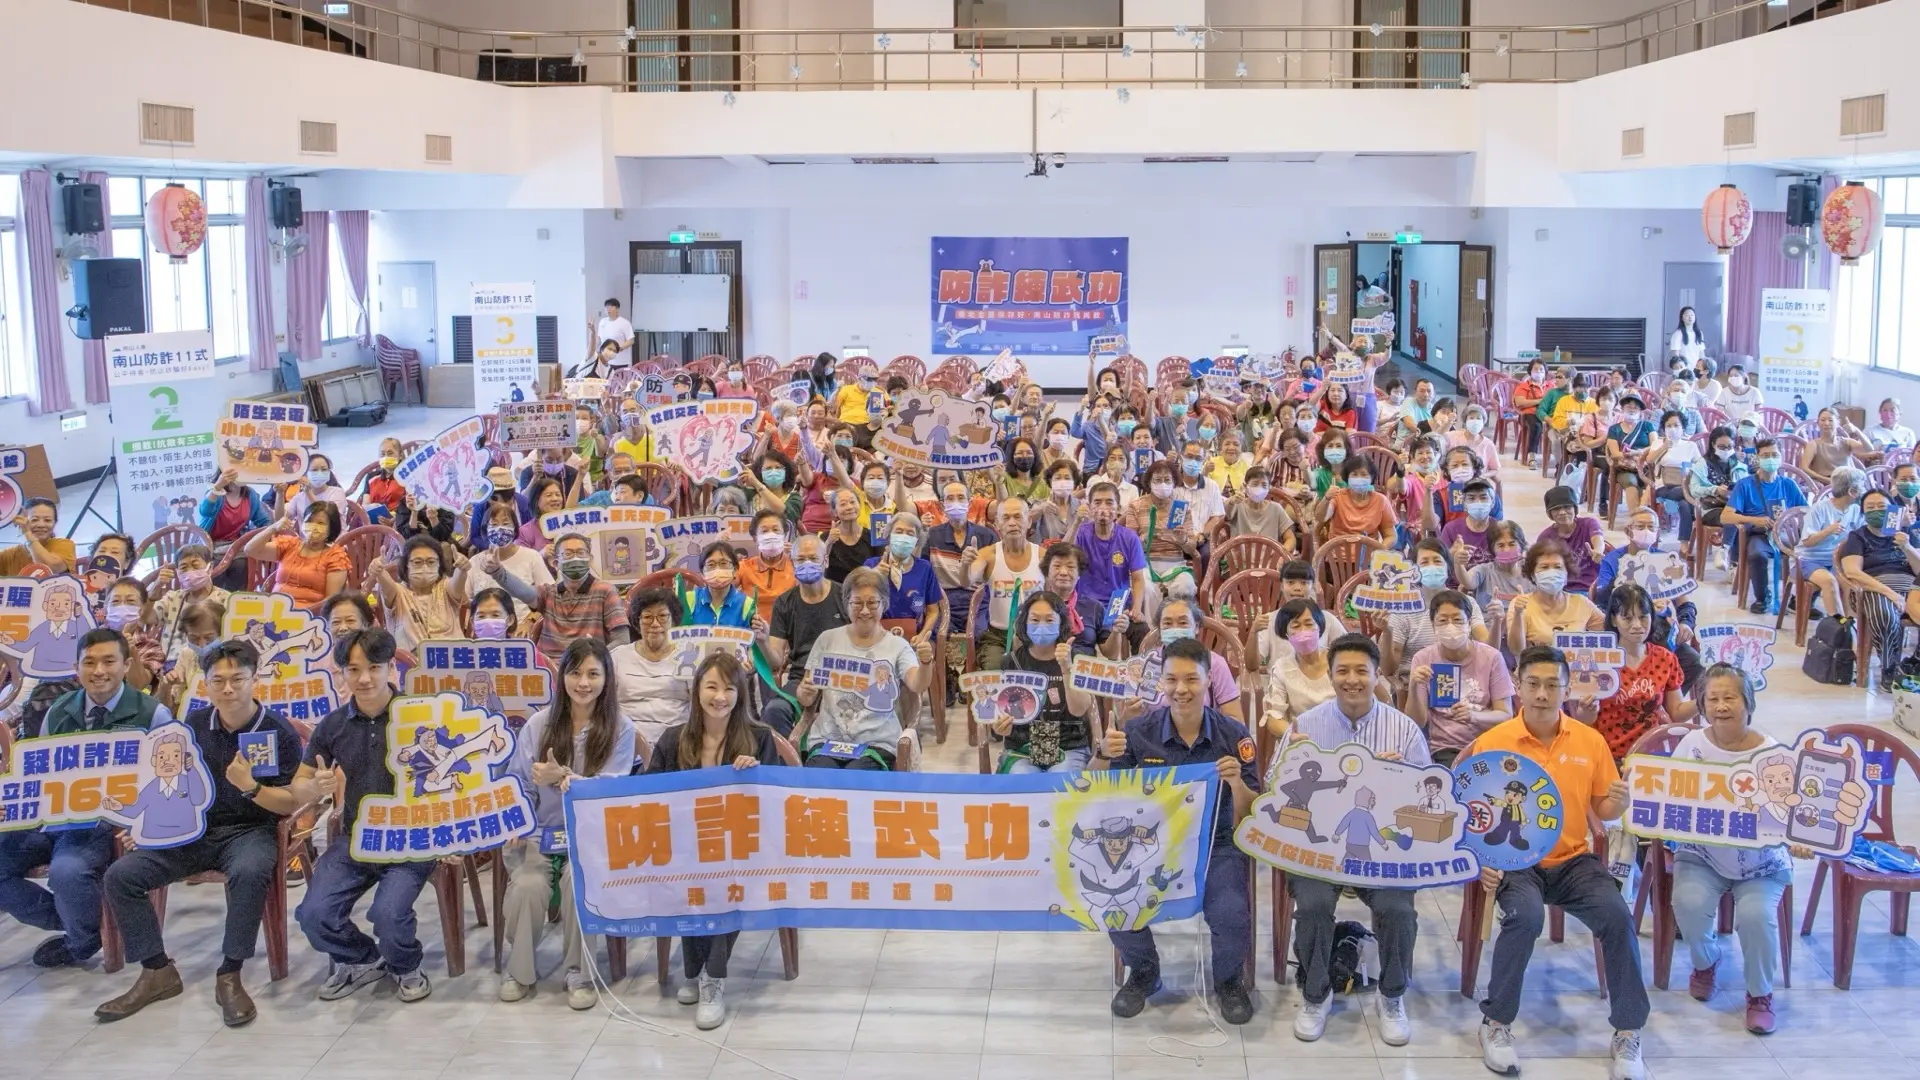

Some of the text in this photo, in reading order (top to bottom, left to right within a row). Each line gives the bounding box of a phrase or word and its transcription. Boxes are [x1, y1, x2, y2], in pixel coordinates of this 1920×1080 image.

[474, 295, 533, 304] 南山防詐11式
[937, 269, 1123, 305] 防詐練武功
[1765, 301, 1826, 311] 南山防詐11式
[112, 349, 209, 369] 南山防詐11式
[646, 380, 662, 393] 防
[148, 386, 183, 431] 2
[233, 404, 304, 422] 陌生來電
[426, 647, 528, 669] 陌生來電
[1076, 660, 1118, 679] 不加入
[831, 671, 869, 692] 165
[23, 740, 141, 777] 疑似詐騙
[2, 780, 42, 800] 立刻
[43, 773, 139, 815] 165
[1633, 764, 1736, 804] 不加入
[367, 785, 516, 826] 學會防詐新方法
[1530, 776, 1559, 831] 165
[1631, 800, 1758, 841] 可疑群組
[361, 805, 527, 852] 顧好老本不用怕
[605, 794, 1030, 871] 防詐練武功
